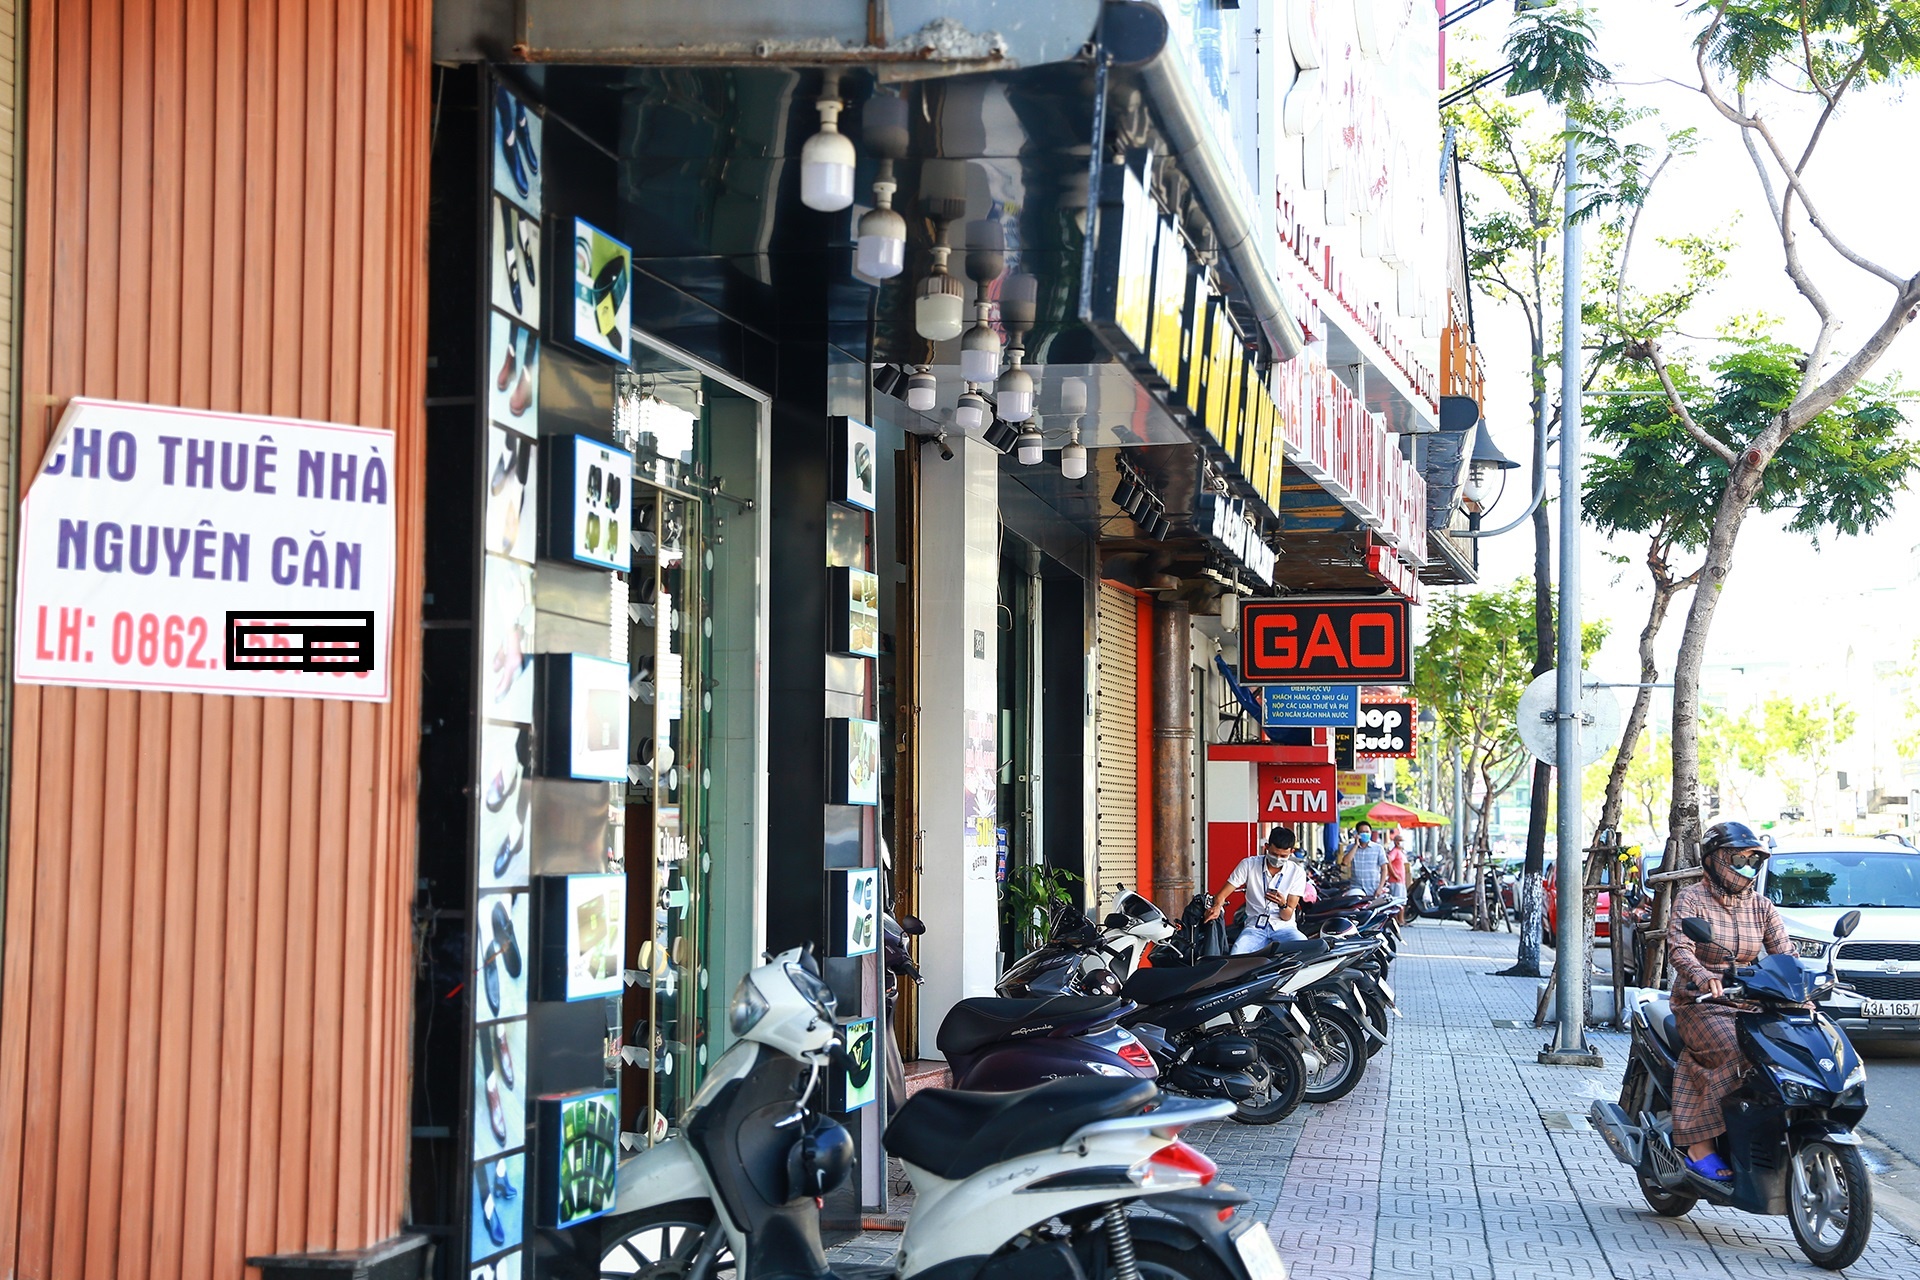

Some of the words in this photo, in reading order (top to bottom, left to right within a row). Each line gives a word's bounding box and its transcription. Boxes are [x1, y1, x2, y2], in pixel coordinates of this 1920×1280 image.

[158, 434, 278, 494] THUÊ
[297, 446, 388, 505] NHÀ
[57, 518, 251, 583] NGUYÊN
[271, 529, 362, 591] CĂN
[35, 605, 96, 664] LH:
[1254, 613, 1394, 669] GAO
[1272, 693, 1292, 701] KHÁCH
[1293, 693, 1311, 701] HÀNG
[1312, 693, 1320, 701] CÓ
[1321, 693, 1335, 701] NHU
[1272, 702, 1284, 710] NỘP
[1285, 702, 1297, 710] CÁC
[1298, 702, 1312, 711] LOẠI
[1313, 702, 1329, 710] THUẾ
[1329, 702, 1338, 710] VÀ
[1338, 702, 1349, 710] PHÍ
[1302, 711, 1317, 719] SÁCH
[1331, 711, 1349, 719] NƯỚC
[1356, 733, 1404, 751] Sudo
[1267, 789, 1328, 812] ATM
